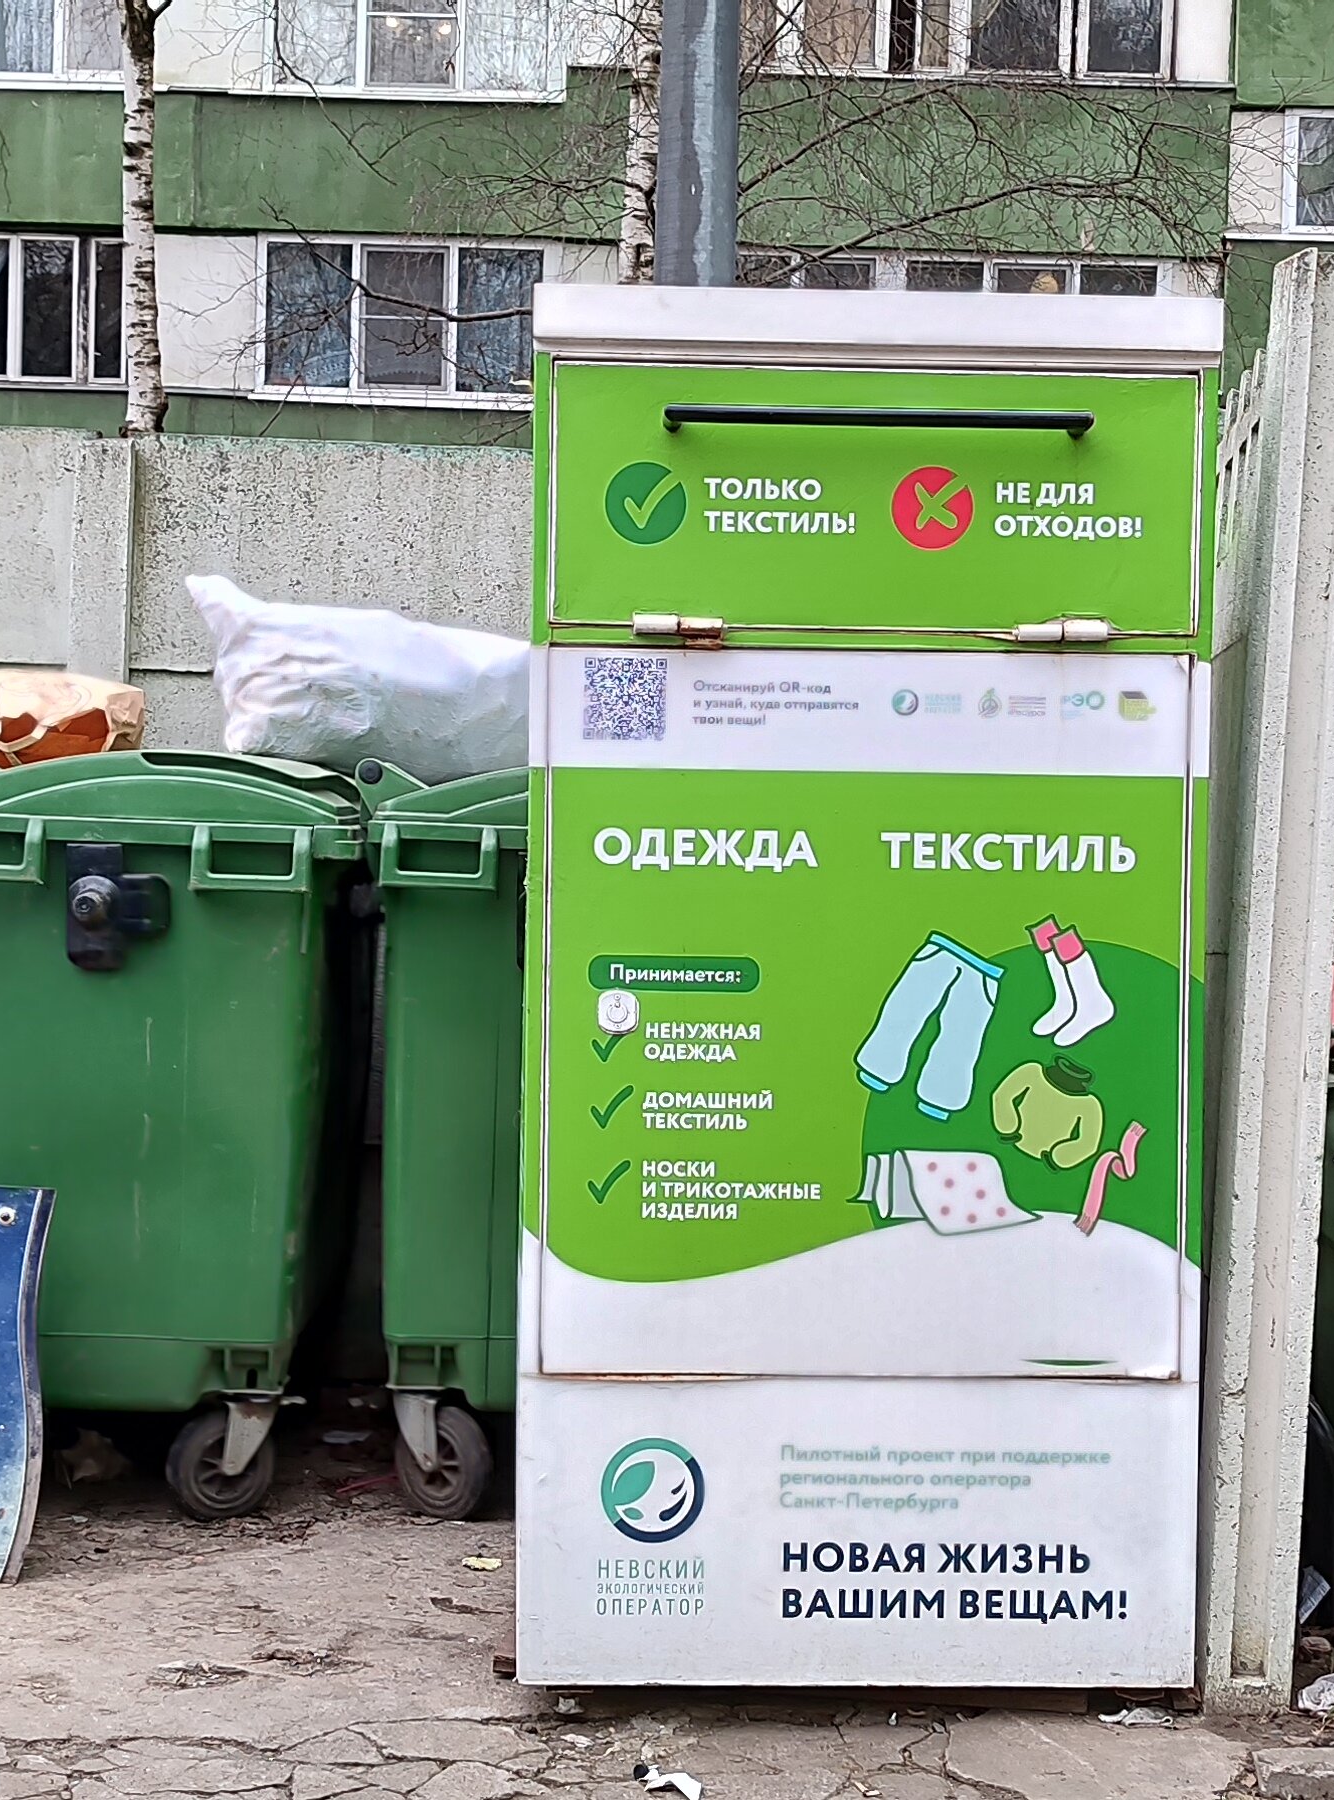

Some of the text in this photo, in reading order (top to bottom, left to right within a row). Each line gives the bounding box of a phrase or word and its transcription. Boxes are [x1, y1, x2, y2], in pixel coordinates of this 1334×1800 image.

[703, 477, 822, 502] ТОЛЬКО
[995, 482, 1095, 511] НЕ ДЛЯ
[703, 509, 856, 535] ТЕКСТИЛЬ!
[994, 514, 1143, 541] ОТХОДОВ!
[692, 680, 832, 696] Отсканируй QR-код
[783, 701, 860, 713] отправятся
[692, 713, 766, 727] твои вещи!
[592, 827, 820, 870] ОДЕЖДА
[880, 832, 1137, 873] ТЕКСТИЛЬ
[609, 963, 742, 984] Принимается:
[644, 1022, 762, 1041] НЕНУЖНАЯ
[643, 1043, 737, 1063] ОДЕЖДА
[642, 1088, 774, 1111] ДОМАШНИЙ
[642, 1112, 748, 1131] ТЕКСТИЛЬ
[641, 1160, 716, 1179] НОСКИ
[641, 1182, 822, 1202] И ТРИКОТАЖНЫЕ
[641, 1202, 739, 1221] ИЗДЕЛИЯ
[780, 1444, 1112, 1466] Пилотный проект при поддержке
[779, 1472, 1032, 1489] регионального оператора
[779, 1491, 959, 1512] Санкт-Петербурга
[597, 1555, 705, 1580] НЕВСКИЙ
[781, 1543, 1092, 1575] НОВАЯ ЖИЗНЬ
[596, 1581, 705, 1595] ЭКОЛОГИЧЕСКИЙ
[596, 1597, 705, 1616] ОПЕРАТОР
[781, 1588, 1129, 1625] ВАШИМ ВЕЩАМ!
